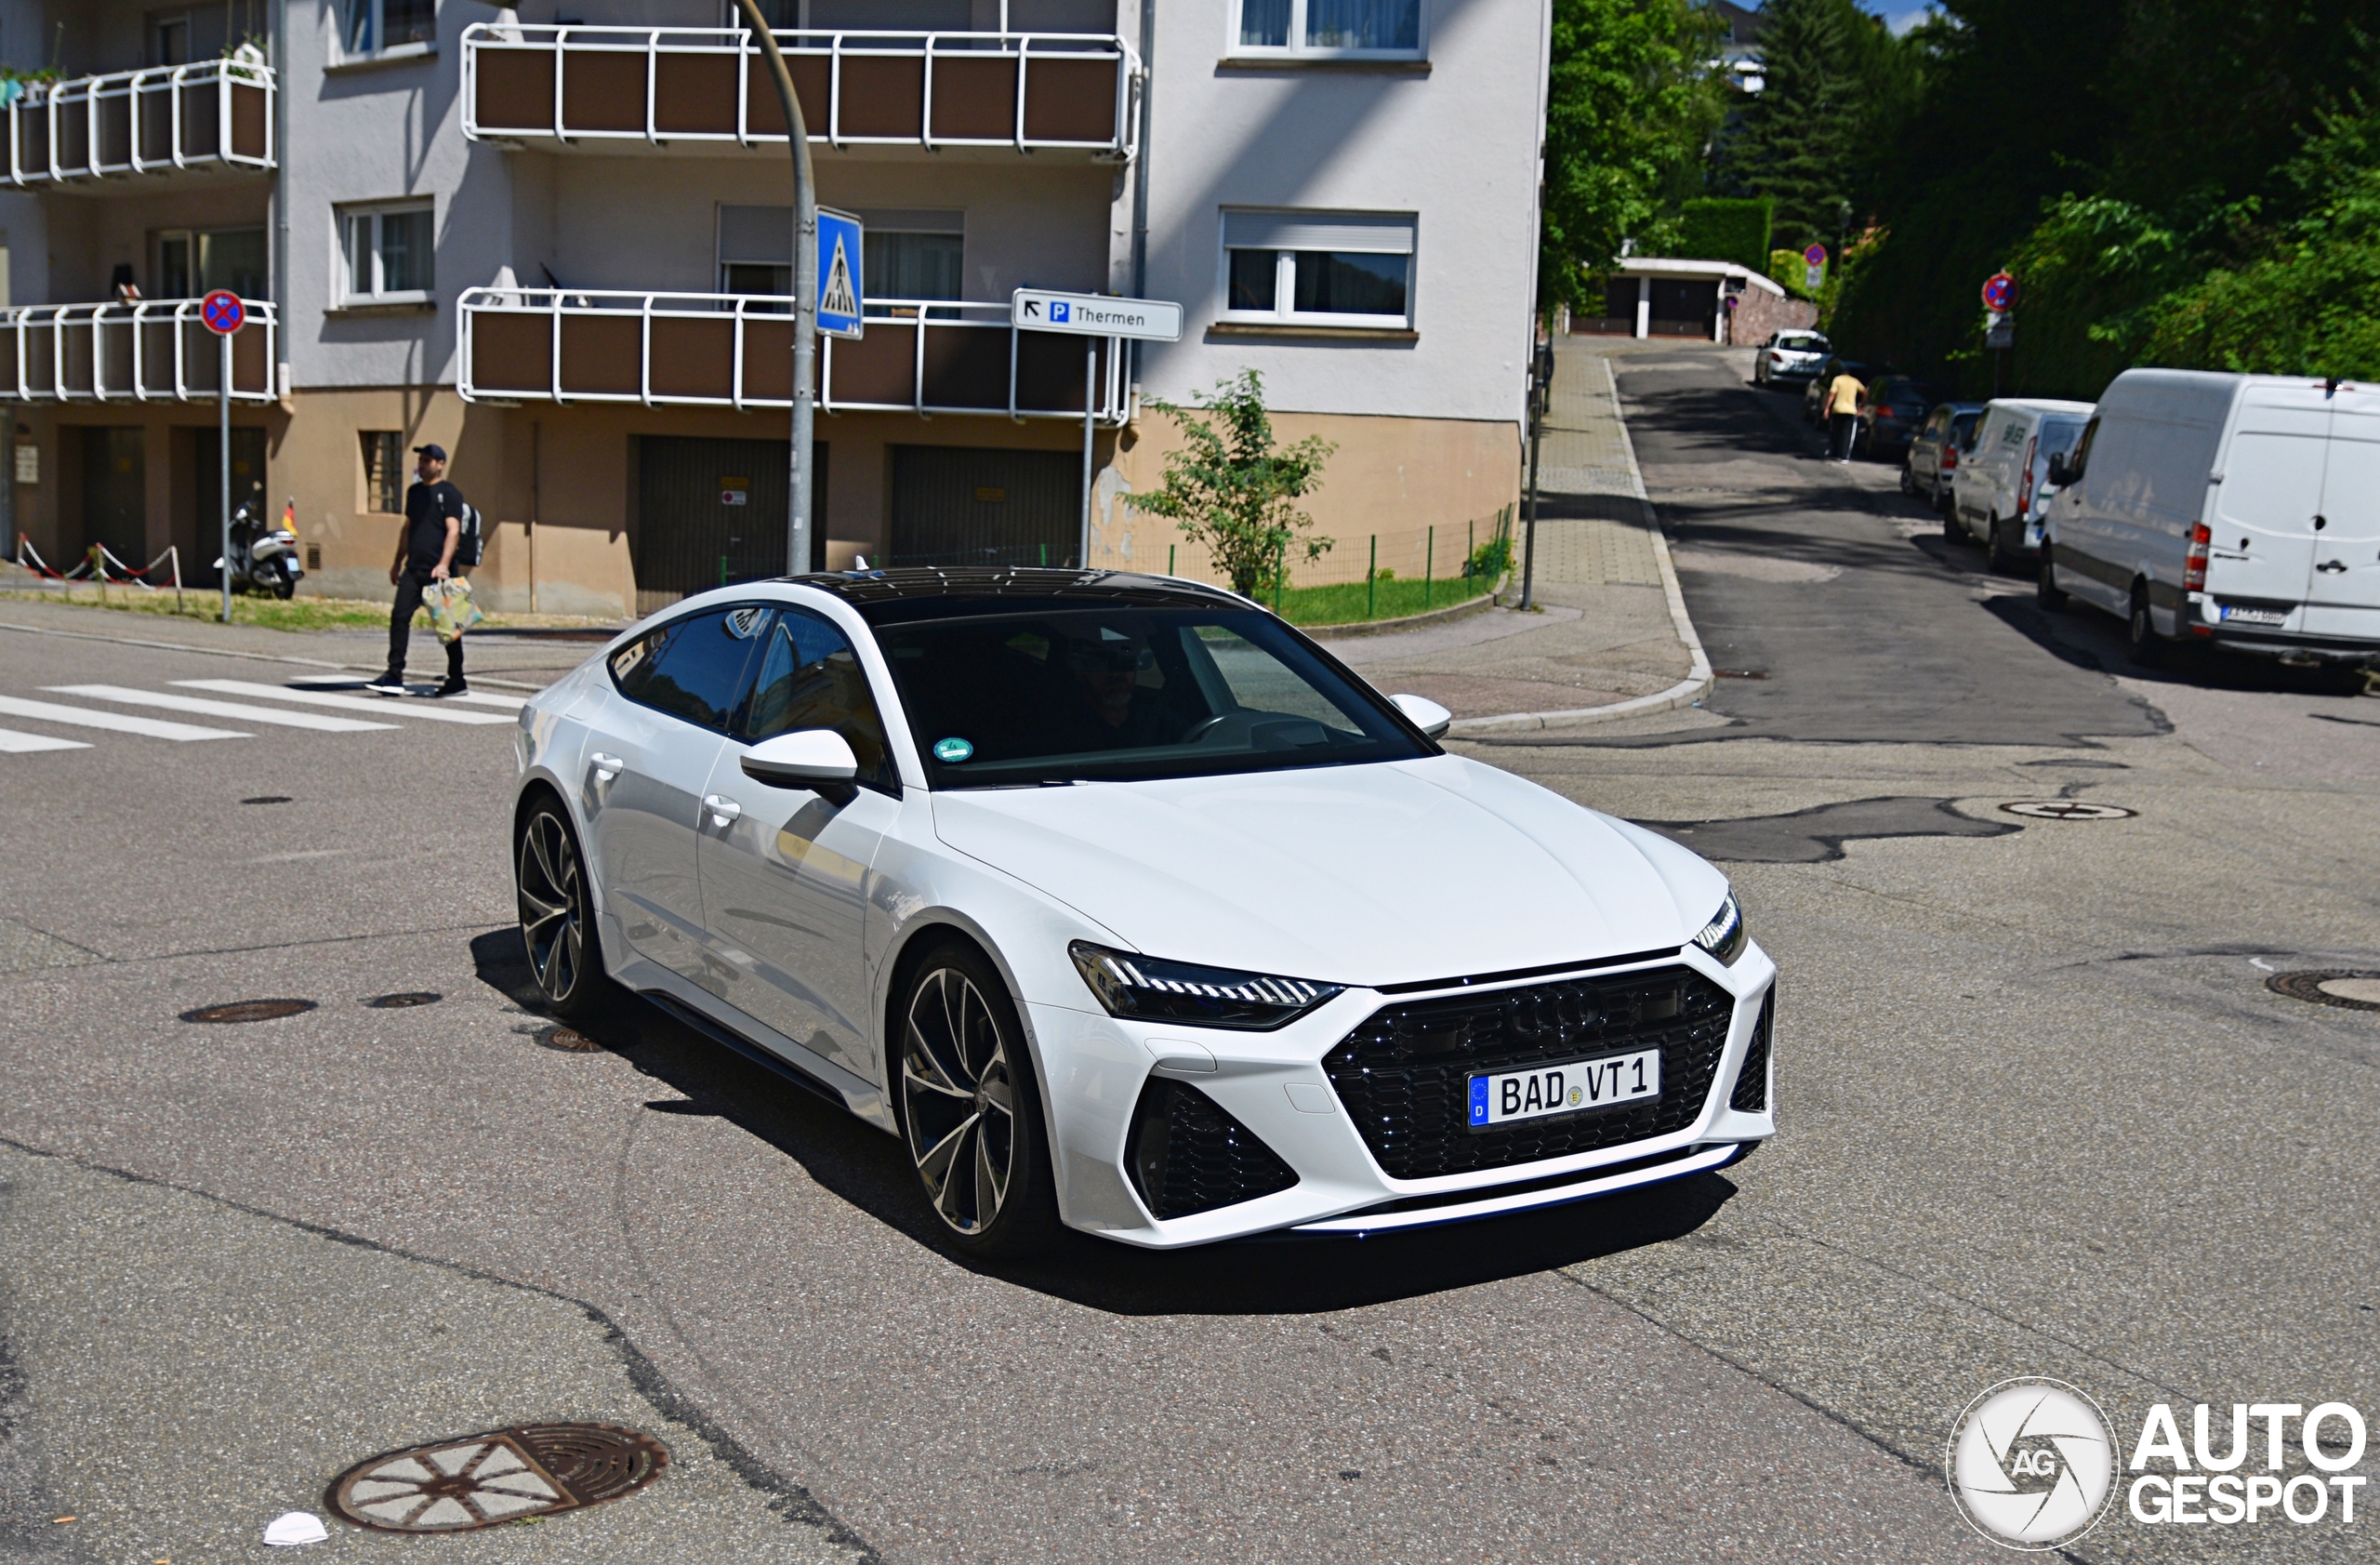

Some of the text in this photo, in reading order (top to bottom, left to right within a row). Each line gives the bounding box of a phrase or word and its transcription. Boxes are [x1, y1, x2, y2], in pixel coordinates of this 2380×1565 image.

[1053, 303, 1144, 326] P Thermen
[948, 741, 958, 750] 4
[1501, 1071, 1564, 1116] BAD
[1475, 1106, 1483, 1117] D
[1527, 1118, 1542, 1126] AUTO
[1547, 1113, 1576, 1123] HOFMANN
